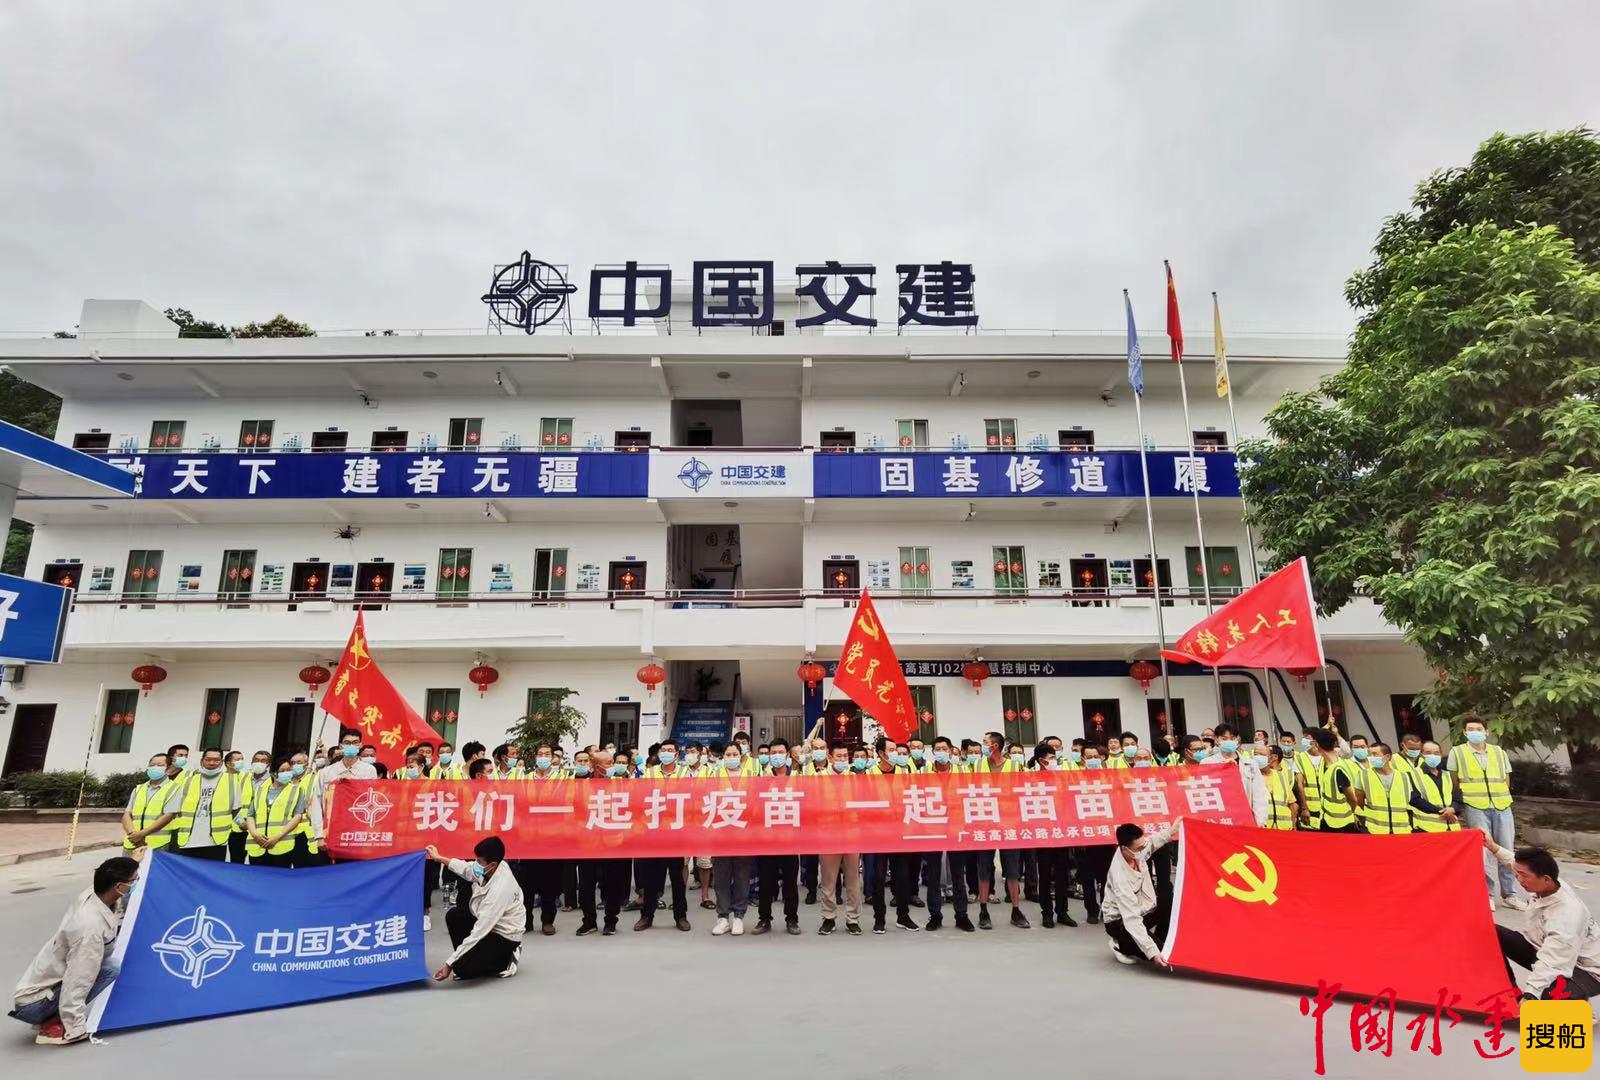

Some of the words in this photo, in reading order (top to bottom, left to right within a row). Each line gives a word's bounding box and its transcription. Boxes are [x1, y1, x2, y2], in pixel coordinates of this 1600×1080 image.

[589, 261, 978, 327] 中国交建
[341, 456, 579, 494] 建者无疆
[721, 465, 786, 479] 中国交建
[880, 456, 1108, 493] 固基修道
[412, 787, 804, 831] 我们一起打疫苗
[845, 775, 1226, 824] 一起苗苗苗苗苗
[340, 831, 393, 842] 中国交建
[254, 915, 408, 957] 中国交建
[252, 962, 277, 972] CHINA
[281, 957, 350, 972] COMMUNICATIONS
[353, 949, 409, 966] CONSTRUCTION
